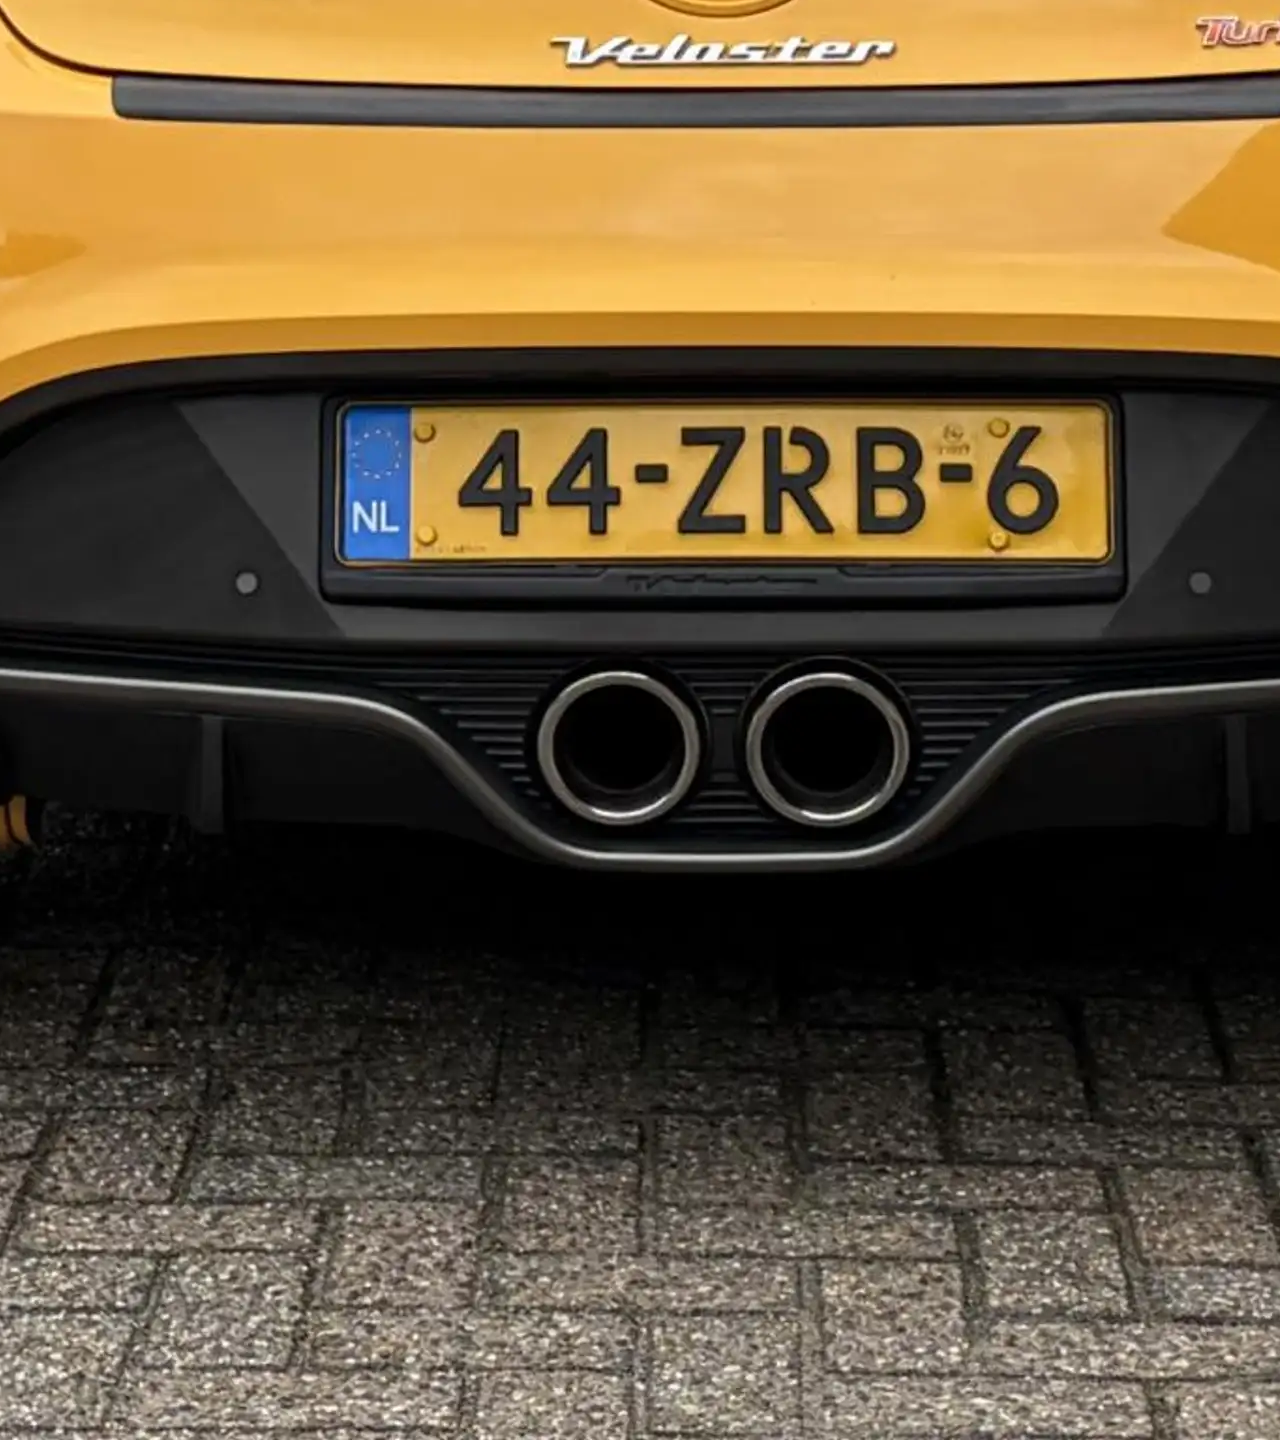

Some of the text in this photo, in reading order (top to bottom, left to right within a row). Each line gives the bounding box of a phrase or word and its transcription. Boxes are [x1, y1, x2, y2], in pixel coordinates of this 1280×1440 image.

[551, 34, 898, 66] Veloster
[458, 426, 1060, 536] 44-ZRB-6
[352, 500, 400, 533] NL
